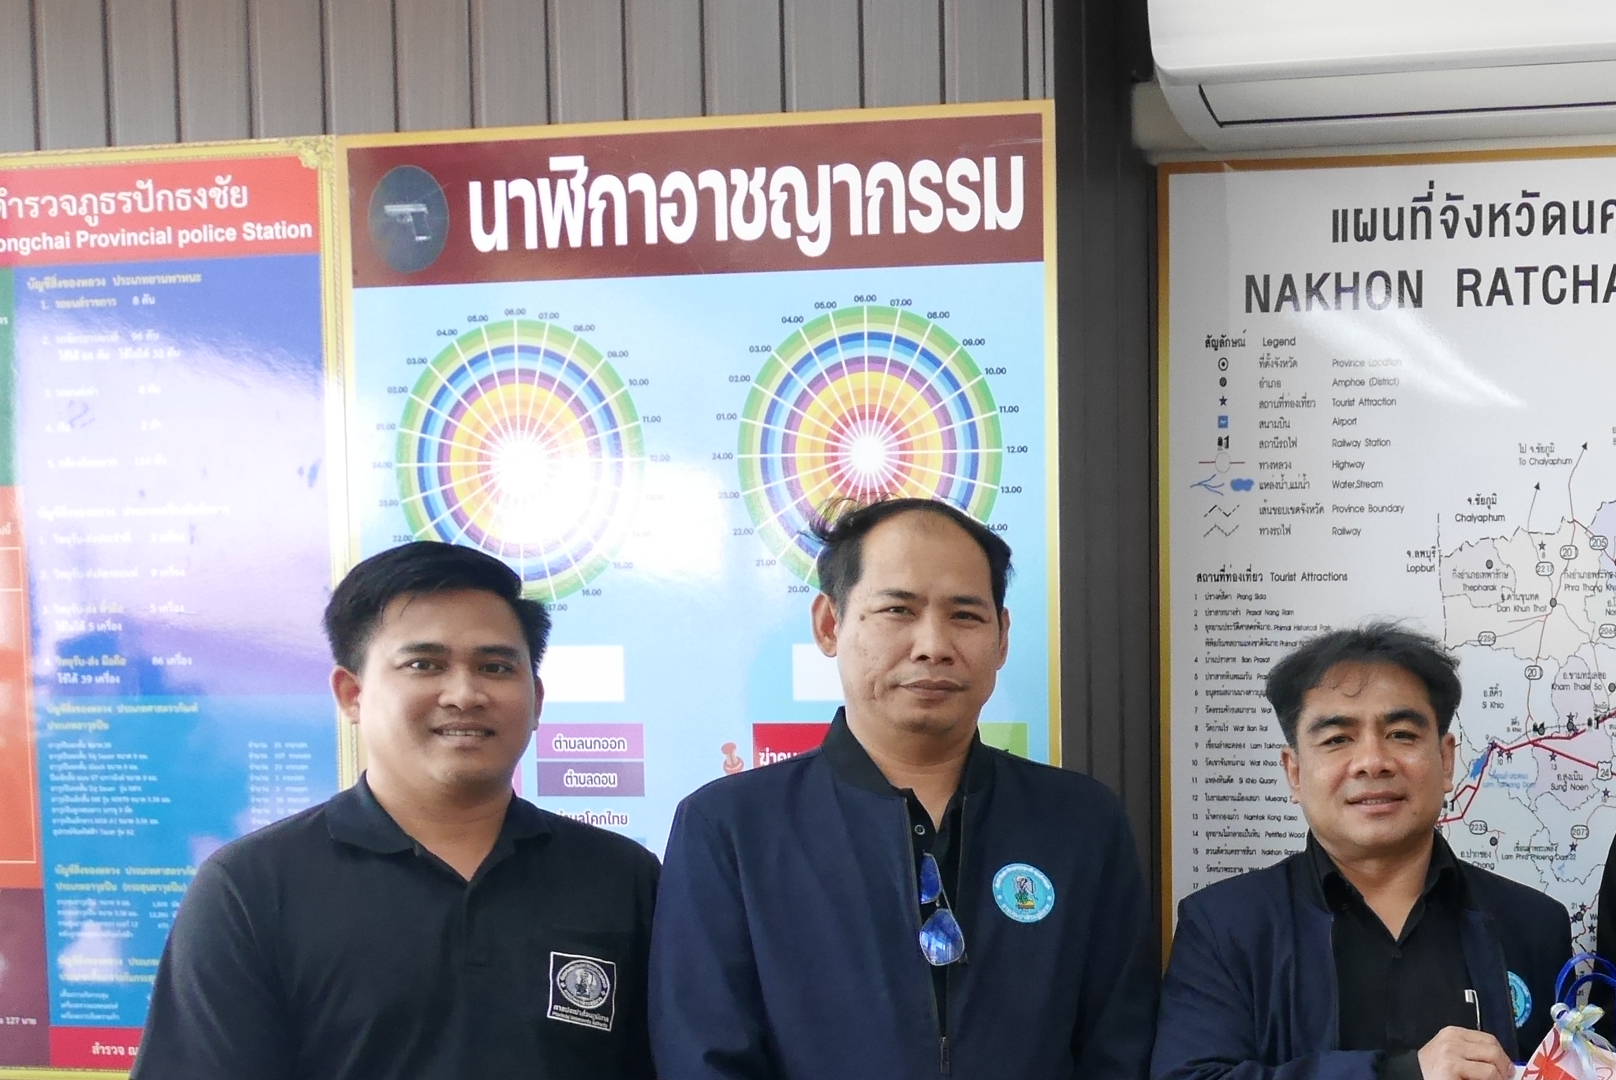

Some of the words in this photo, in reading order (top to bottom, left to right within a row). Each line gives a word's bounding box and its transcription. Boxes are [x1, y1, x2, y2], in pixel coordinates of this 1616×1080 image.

[468, 154, 1024, 258] นาฬิกาอาชญากรรม
[76, 226, 172, 248] Provincial
[178, 224, 237, 248] police
[242, 221, 312, 241] Station
[1245, 268, 1424, 315] NAKHON
[853, 294, 877, 303] 06.00
[890, 298, 912, 307] 07.00
[814, 301, 837, 310] 05.00
[781, 315, 804, 324] 04.00
[927, 311, 950, 320] 08.00
[962, 338, 985, 347] 09.00
[1262, 337, 1296, 348] Legend
[749, 345, 772, 353] 03.00
[1332, 357, 1365, 368] Province
[984, 366, 1007, 376] 10.00
[1332, 377, 1365, 388] Amphoe
[1332, 397, 1355, 407] Tourist
[1358, 397, 1397, 407] Attraction
[998, 405, 1019, 414] 11.00
[642, 415, 661, 424] 11.00
[1332, 417, 1357, 428] Airport
[1332, 438, 1361, 449] Railway
[1364, 437, 1391, 447] Station
[1006, 445, 1028, 454] 12.00
[1332, 460, 1365, 470] Highway
[1529, 457, 1573, 467] Chaiyaphum
[1000, 485, 1022, 494] 13.00
[1332, 504, 1365, 514] Province
[1368, 503, 1405, 514] Boundary
[1455, 513, 1505, 524] Chaiyaphum
[1332, 526, 1361, 537] Railway
[1592, 538, 1607, 546] 205
[1406, 563, 1436, 574] Lopburi
[1270, 572, 1297, 582] Tourist
[1301, 571, 1348, 582] Attractions
[787, 585, 810, 594] 20.00
[1463, 584, 1497, 592] Thepharak
[1497, 604, 1511, 612] Dan
[1513, 604, 1531, 612] Khun
[1490, 701, 1504, 710] Khio
[553, 733, 627, 752] ตำบลนกออก
[1600, 768, 1610, 778] 24
[565, 771, 616, 787] ตำบลดอน
[1550, 783, 1567, 792] Sung
[1569, 783, 1589, 791] Noen
